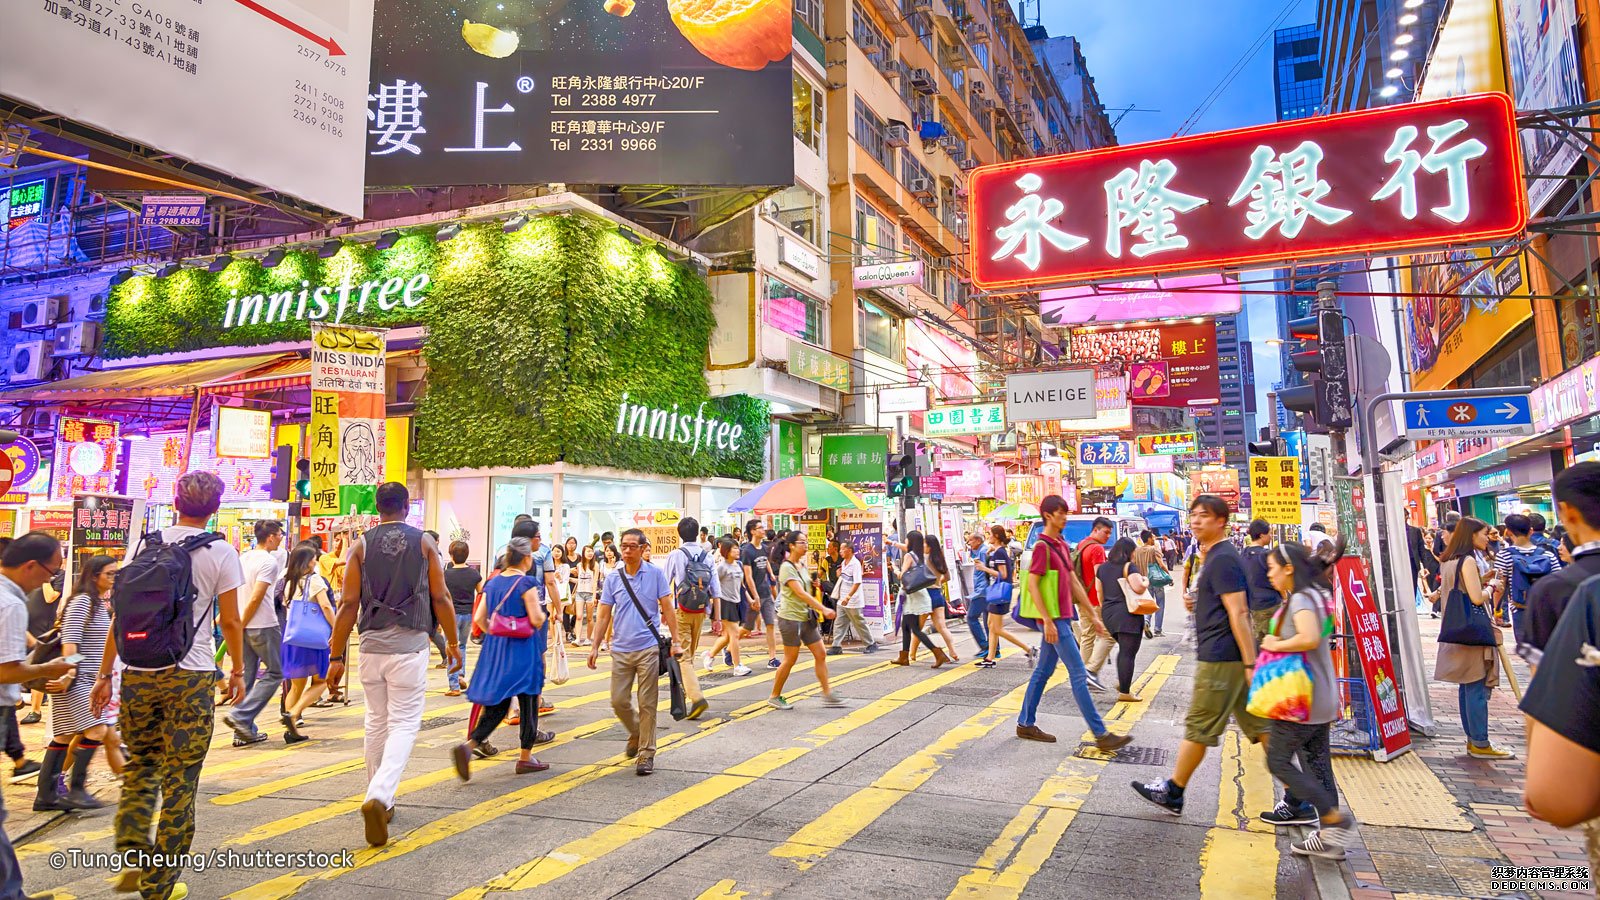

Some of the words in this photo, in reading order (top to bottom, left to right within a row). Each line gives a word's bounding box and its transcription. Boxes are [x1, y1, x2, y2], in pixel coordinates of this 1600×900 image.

[297, 44, 321, 62] 2577
[324, 59, 346, 76] 6778
[551, 75, 705, 90] 旺角永隆銀行中心20/F
[295, 79, 318, 97] 2411
[322, 92, 345, 110] 5008
[551, 94, 571, 106] Tel
[581, 94, 617, 106] 2388
[622, 94, 657, 106] 4977
[294, 94, 317, 111] 2721
[321, 106, 344, 124] 9308
[293, 108, 317, 126] 2369
[320, 121, 343, 138] 6186
[550, 138, 570, 151] Tel
[581, 138, 614, 151] 2331
[620, 138, 657, 151] 9966
[991, 118, 1487, 272] 永隆銀行
[859, 273, 878, 281] salon
[223, 268, 431, 329] innisfree
[320, 330, 381, 351] حلال
[1171, 339, 1206, 356] 樓上
[313, 351, 347, 365] MISS
[351, 354, 385, 368] INDIA
[321, 366, 378, 378] RESTAURANT
[1013, 387, 1087, 404] LANEIGE
[616, 393, 742, 456] innisfree
[313, 395, 338, 510] 旺角咖喱
[828, 452, 881, 466] 春藤書坊
[1254, 460, 1294, 472] 高價
[1255, 475, 1295, 488] 收購
[77, 508, 131, 529] 陽光酒店
[316, 517, 335, 531] 57
[85, 529, 101, 540] Sun
[103, 529, 124, 540] Hotel
[656, 536, 677, 544] MISS
[1356, 612, 1380, 634] 人民幣
[1380, 699, 1399, 715] MONEY
[1382, 716, 1407, 739] EXCHANGE
